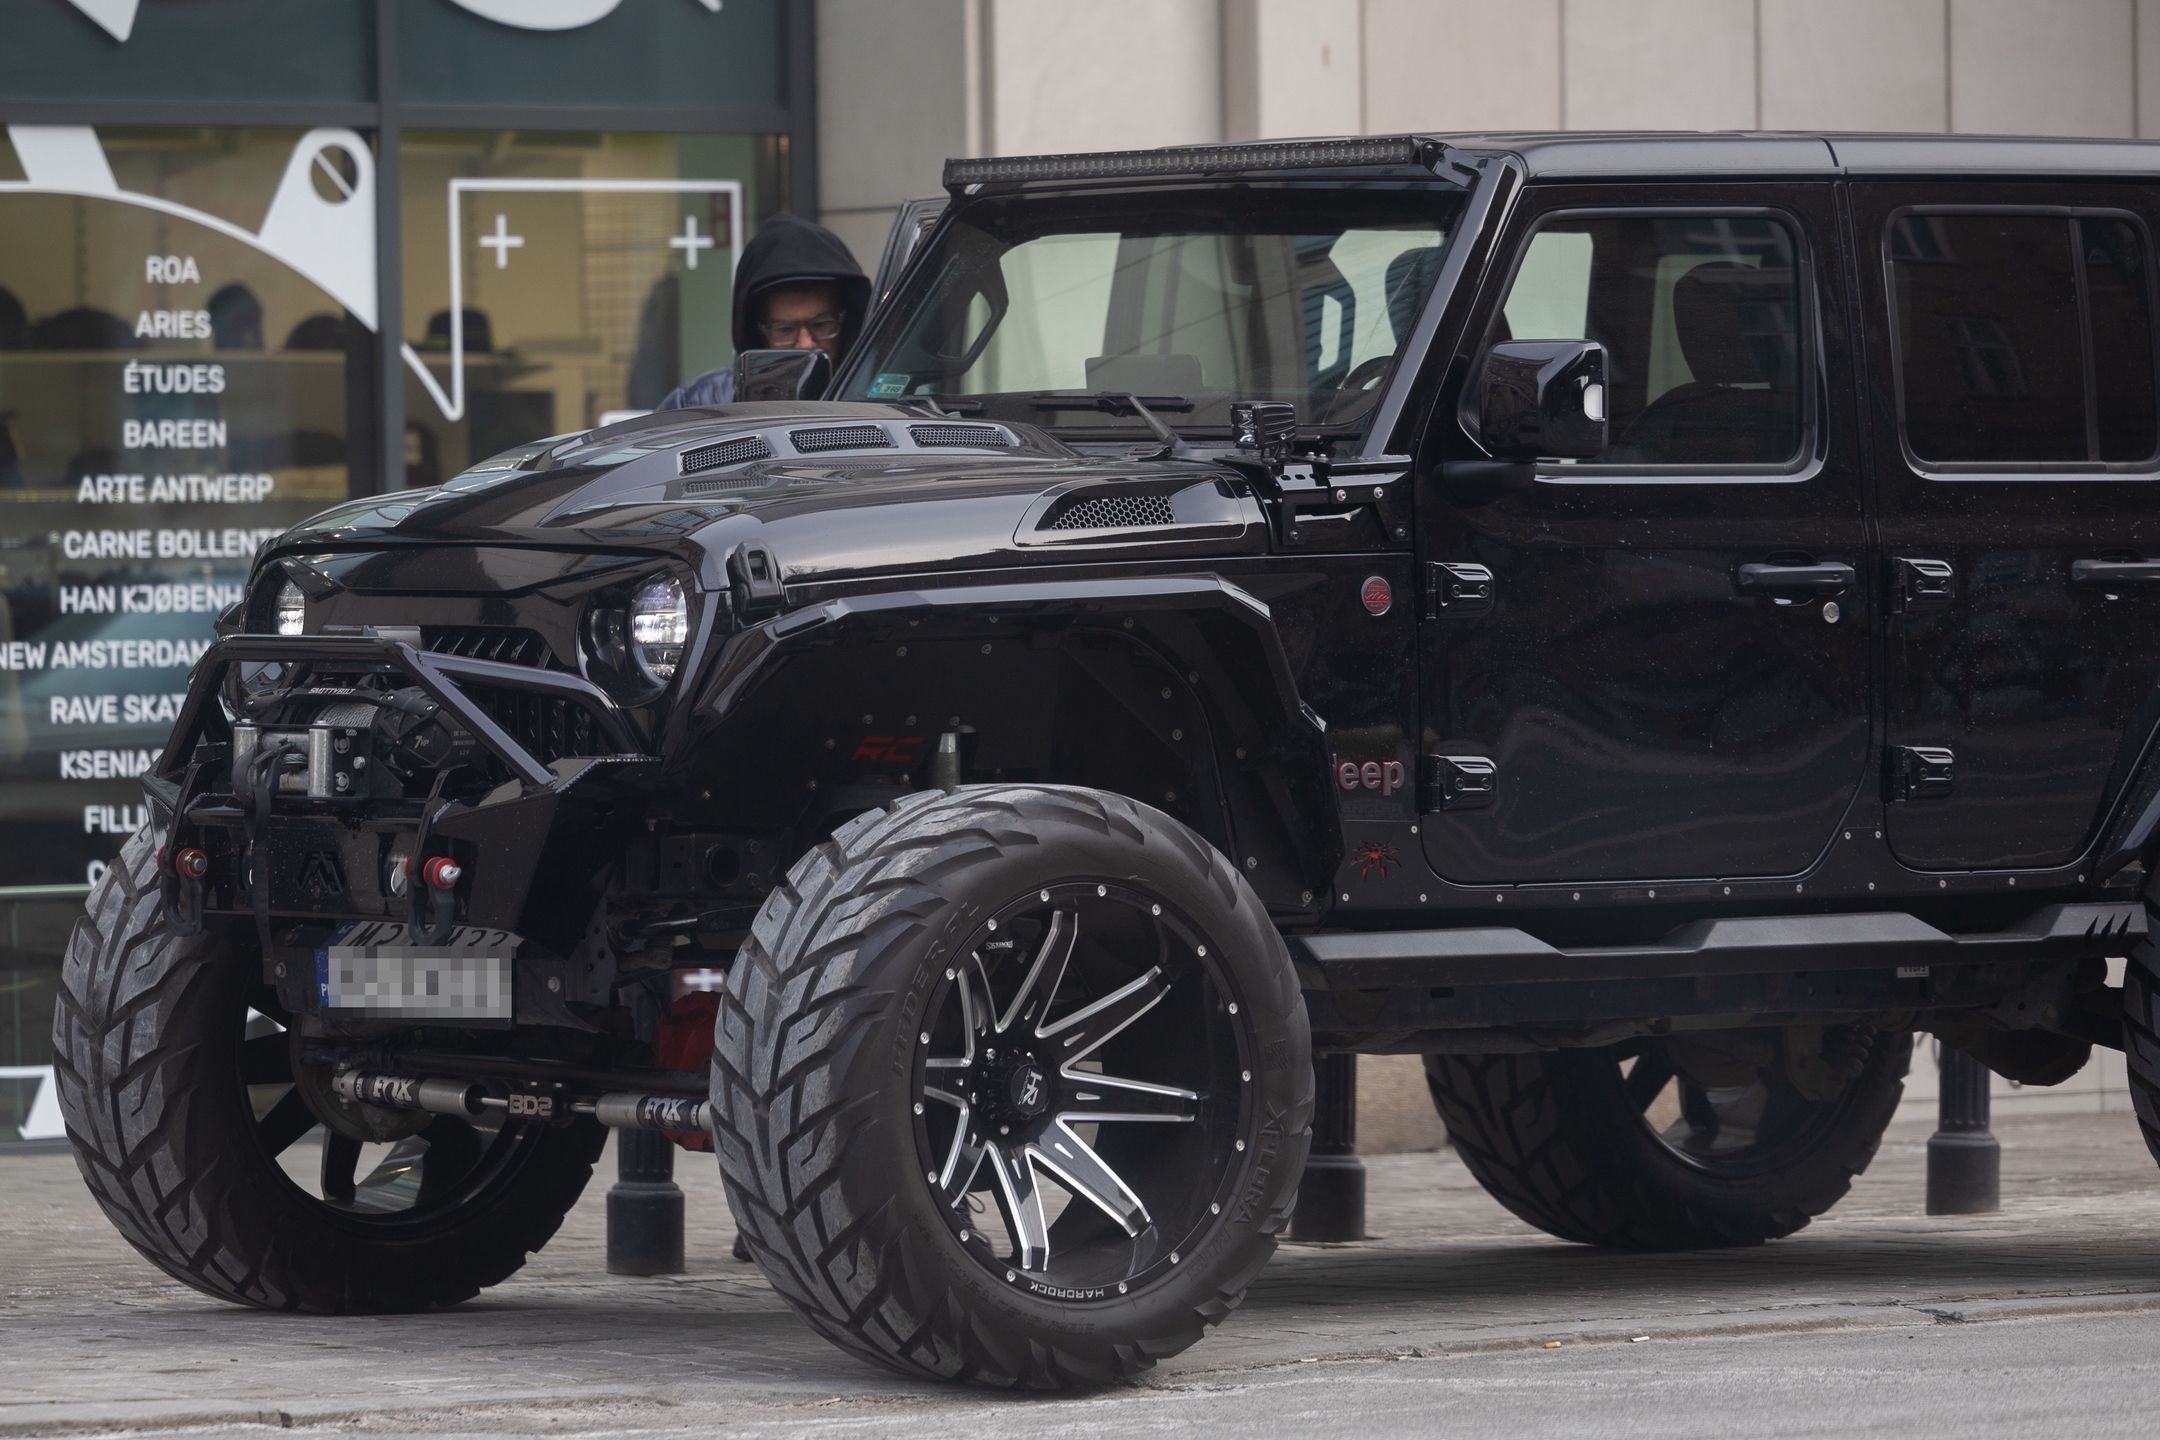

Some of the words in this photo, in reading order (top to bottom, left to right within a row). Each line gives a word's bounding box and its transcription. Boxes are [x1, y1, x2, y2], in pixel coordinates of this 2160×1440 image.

[145, 255, 200, 284] ROA
[135, 310, 212, 339] ARIES
[123, 359, 226, 393] ÉTUDES
[123, 419, 227, 448] BAREEN
[77, 474, 146, 504] ARTE
[150, 474, 274, 504] ANTWERP
[63, 529, 153, 559] CARNE
[157, 528, 286, 559] BOLLENT
[59, 585, 116, 614] HAN
[50, 695, 119, 724] RAVE
[1332, 754, 1405, 796] eep
[1029, 1280, 1105, 1299] HARDROCK
